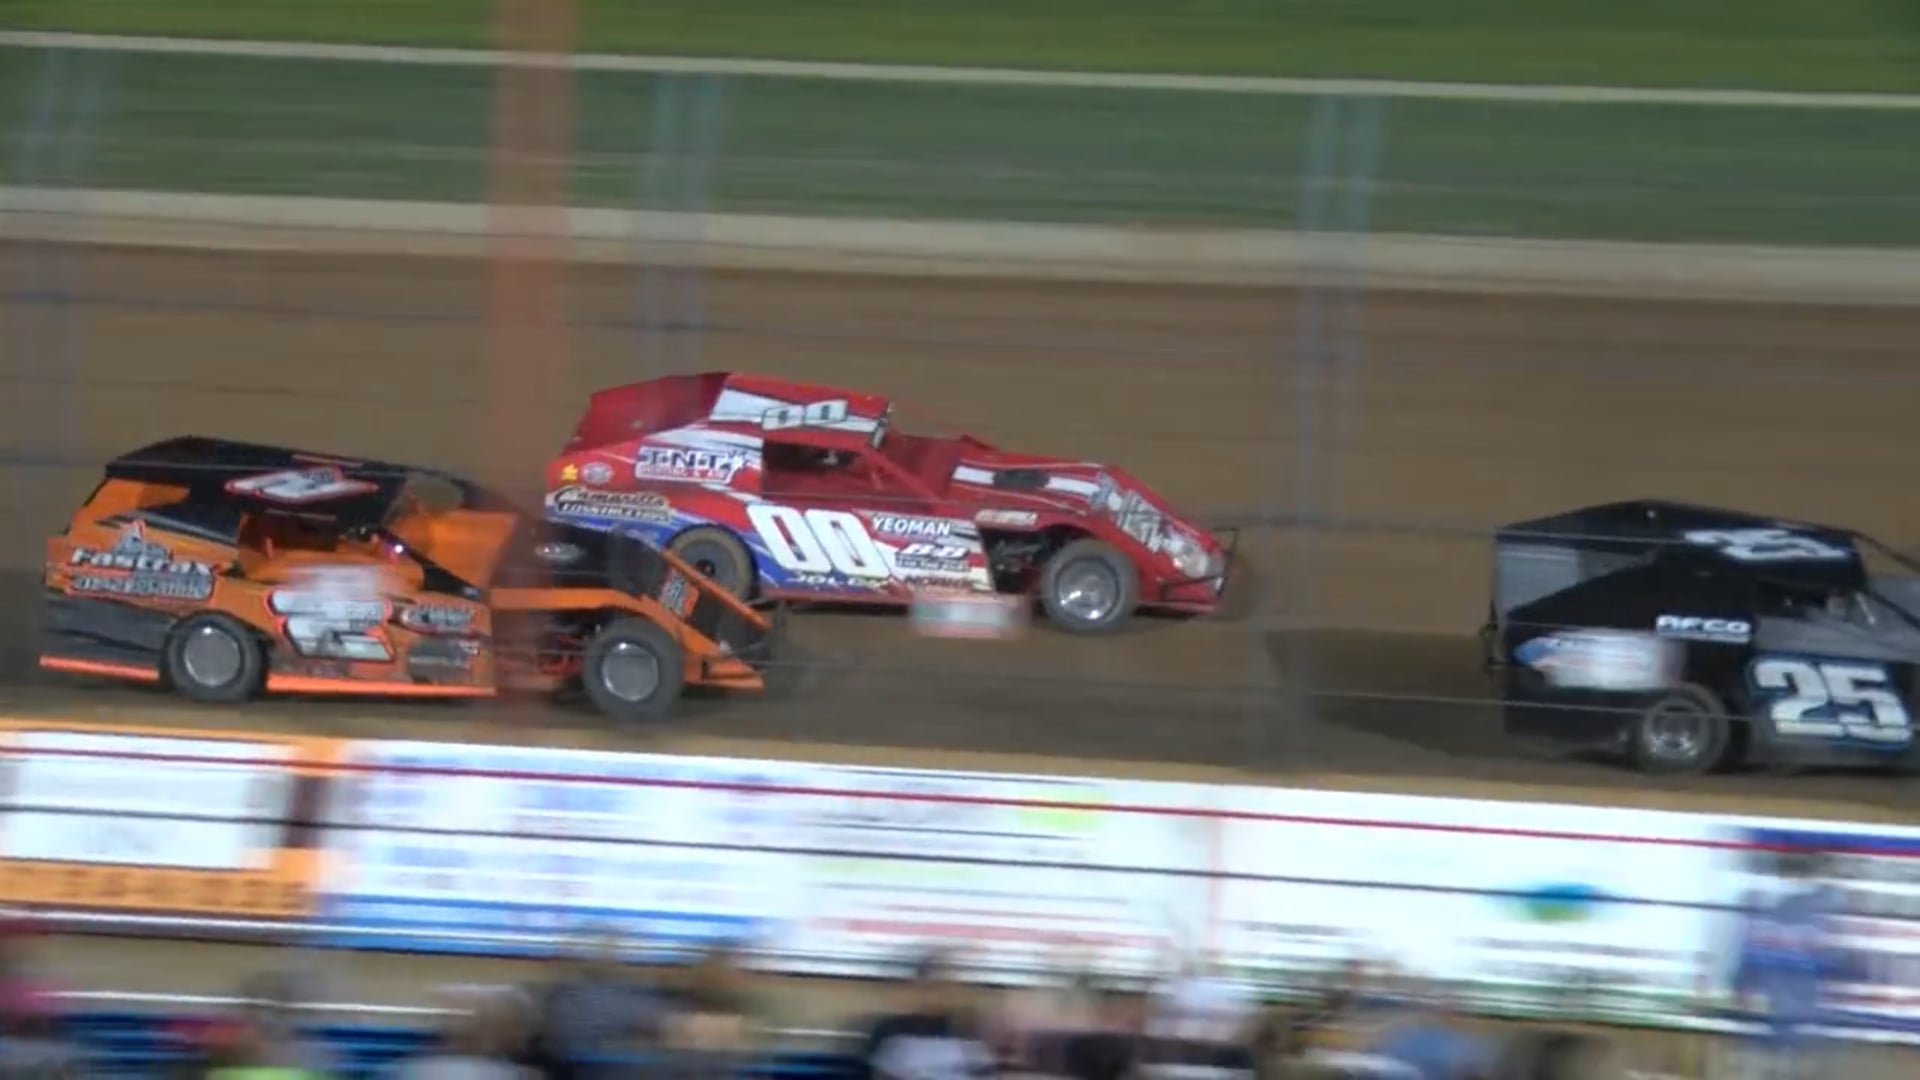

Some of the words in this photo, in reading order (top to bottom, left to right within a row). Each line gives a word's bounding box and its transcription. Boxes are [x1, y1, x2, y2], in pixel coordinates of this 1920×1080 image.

[746, 504, 891, 579] 00
[872, 515, 951, 537] YEOMAN
[1655, 614, 1752, 633] AFCO
[1757, 660, 1912, 741] 25
